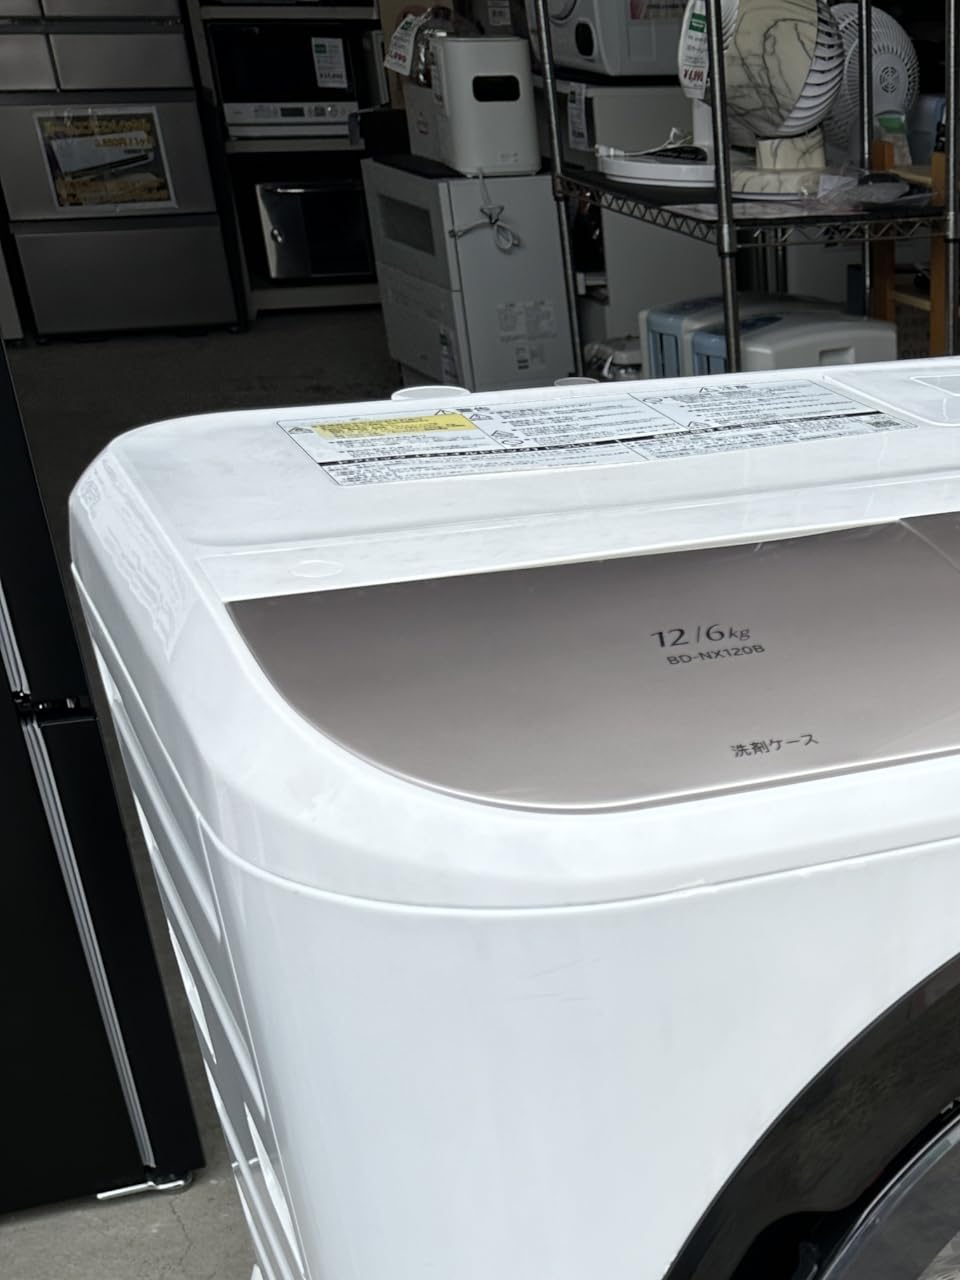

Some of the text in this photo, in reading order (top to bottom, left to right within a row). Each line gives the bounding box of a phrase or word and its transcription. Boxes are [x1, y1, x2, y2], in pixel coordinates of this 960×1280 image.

[666, 644, 766, 665] BD-NX120B
[730, 733, 819, 758] 洗剤ケース
